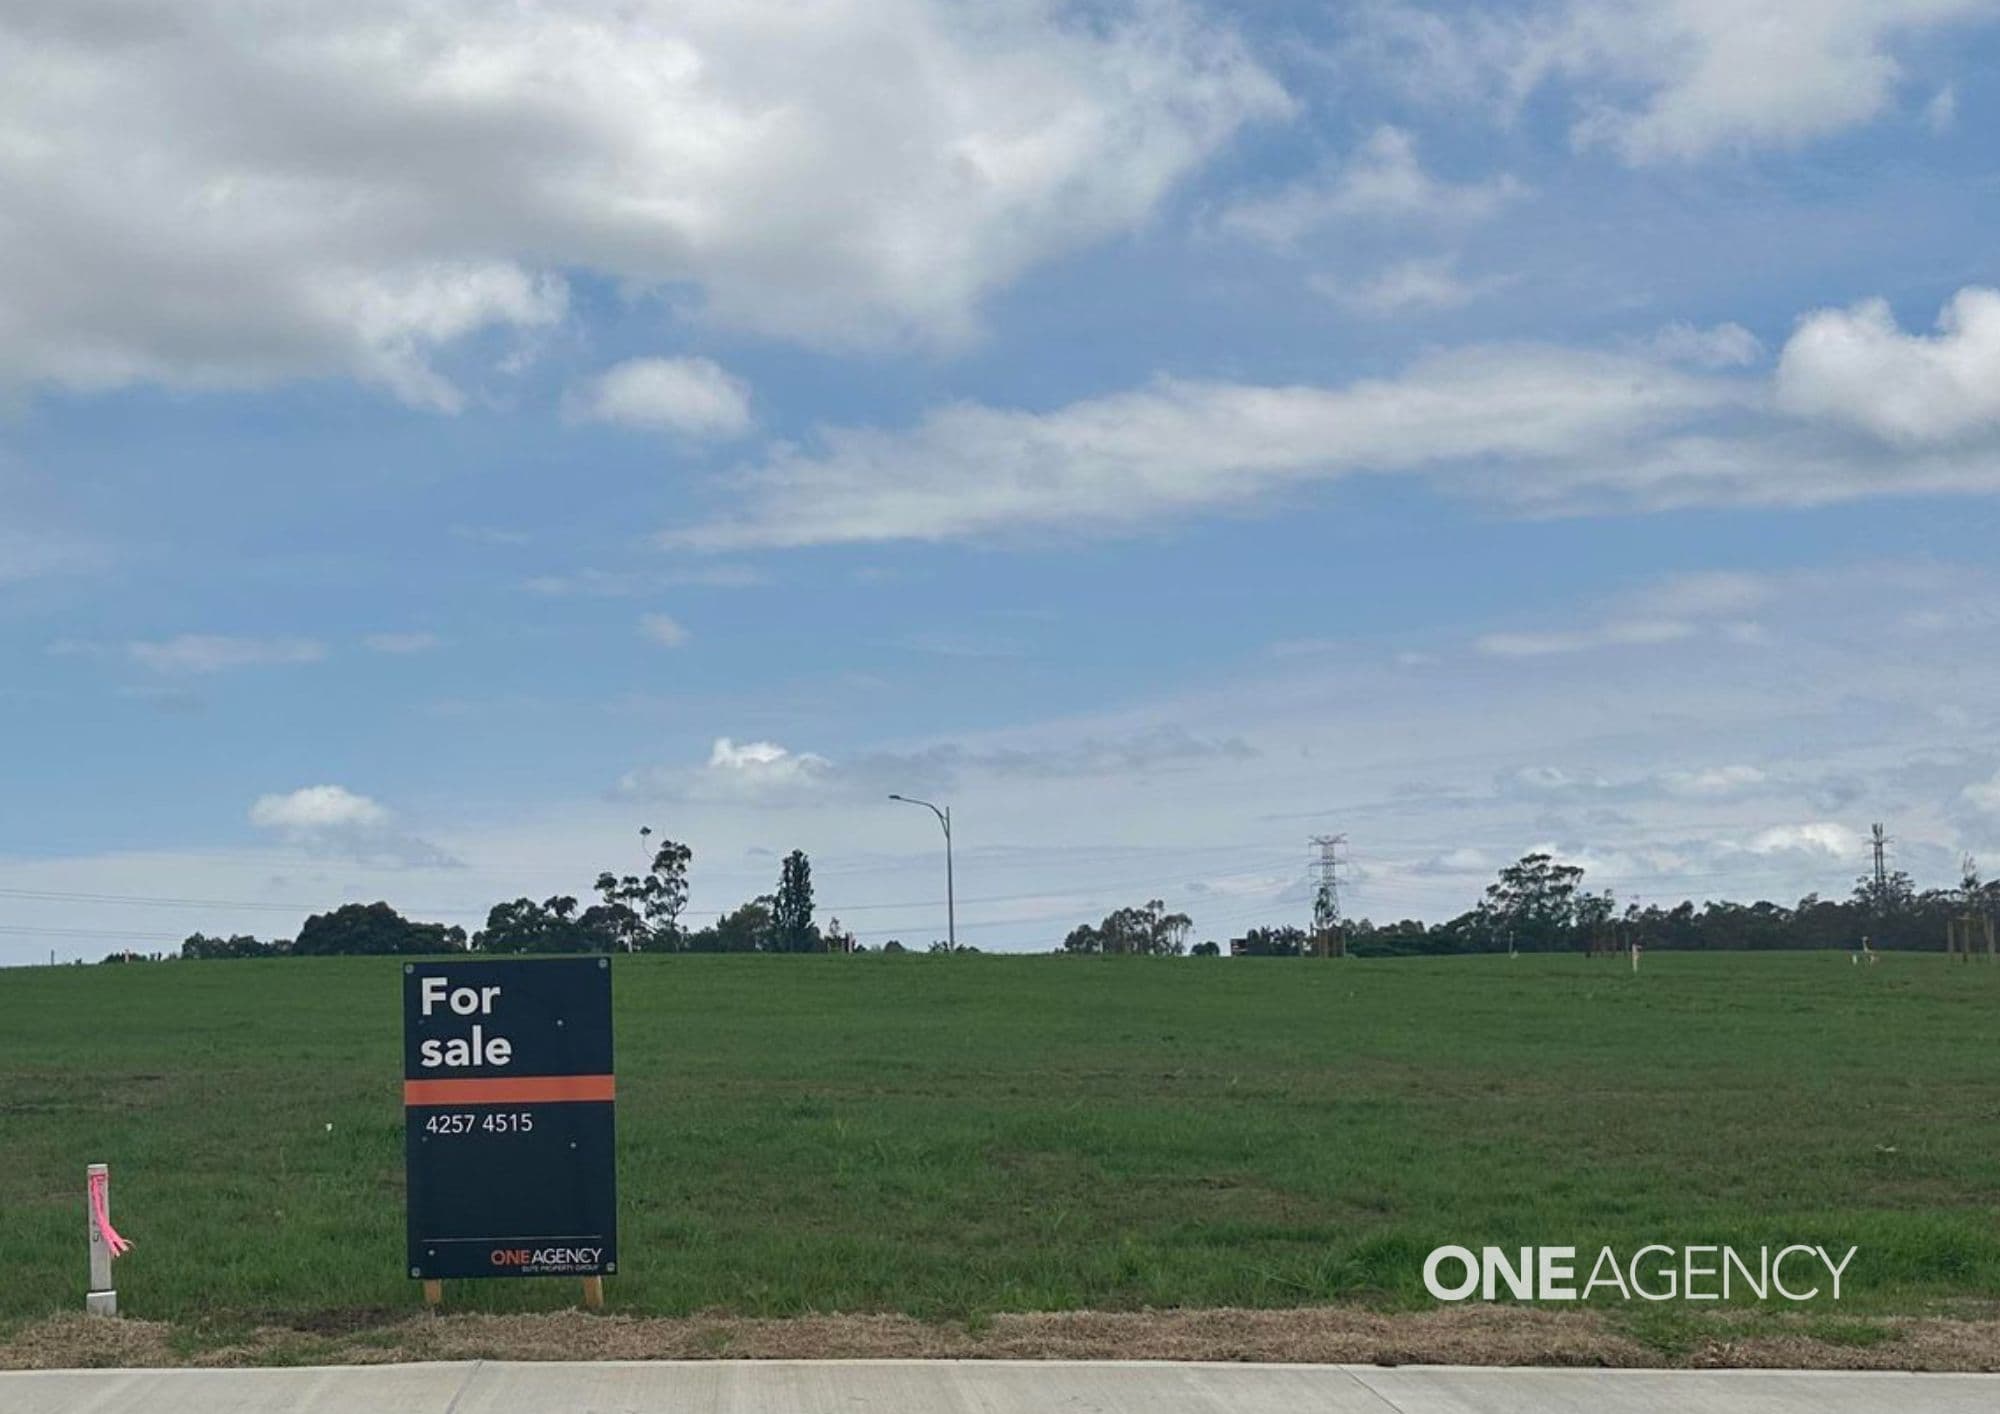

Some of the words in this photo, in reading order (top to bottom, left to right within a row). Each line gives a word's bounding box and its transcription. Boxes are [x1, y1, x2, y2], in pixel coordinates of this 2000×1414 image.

[421, 976, 501, 1016] For
[420, 1025, 512, 1068] sale
[426, 1114, 475, 1134] 4257
[482, 1113, 534, 1132] 4515
